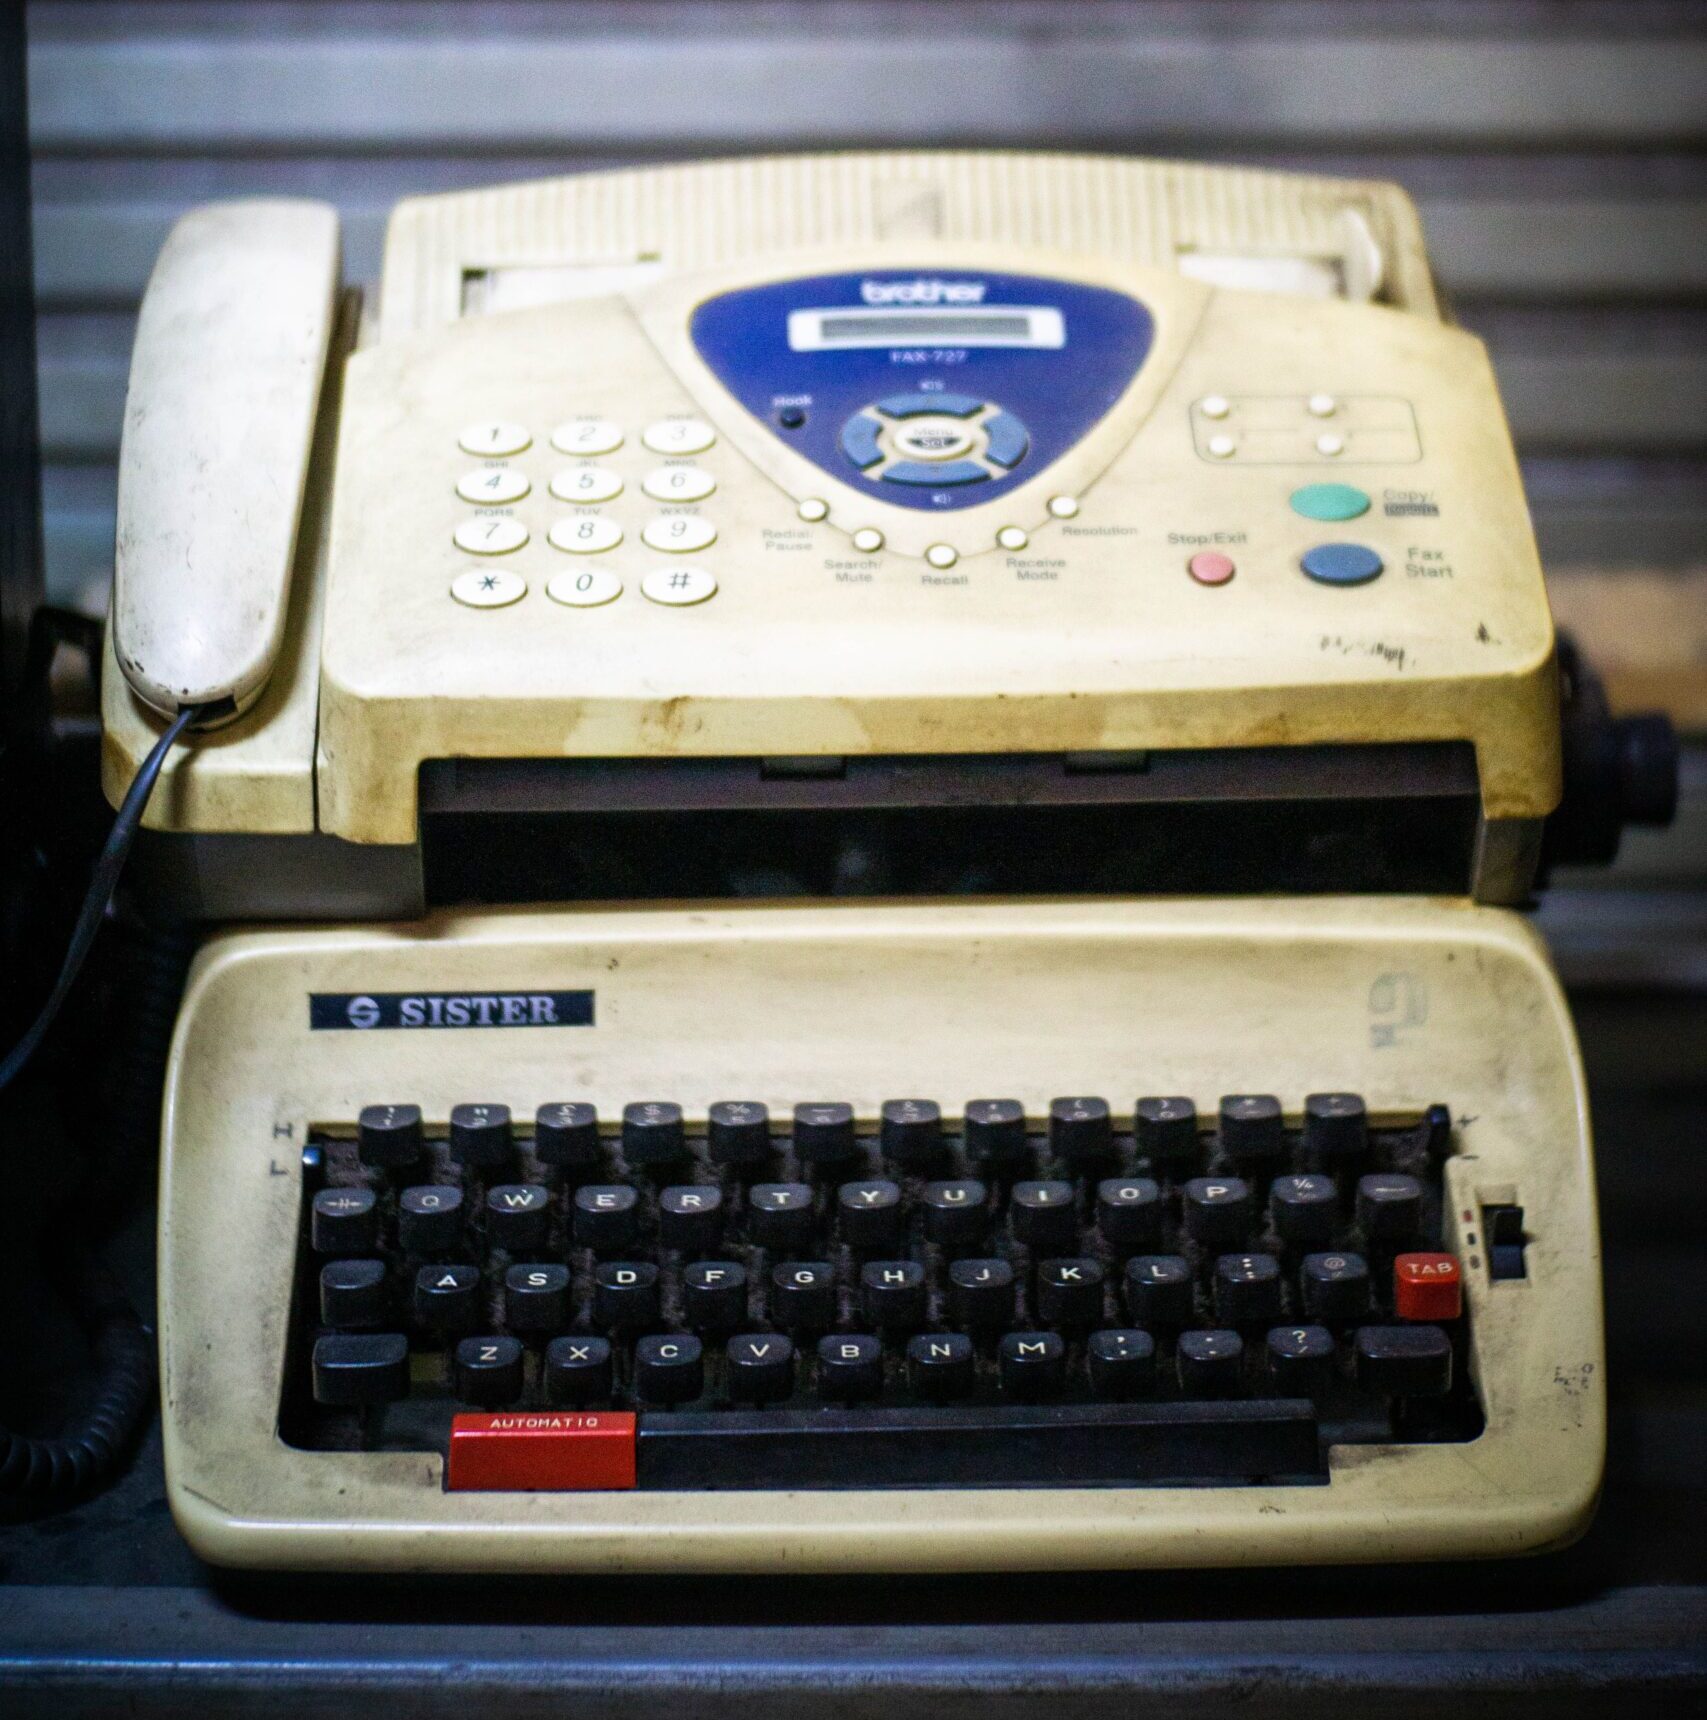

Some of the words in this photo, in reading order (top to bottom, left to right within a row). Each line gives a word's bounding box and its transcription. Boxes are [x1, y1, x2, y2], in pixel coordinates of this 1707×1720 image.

[862, 281, 985, 303] brother
[890, 350, 968, 363] FAX-727
[489, 427, 500, 442] 1
[578, 426, 596, 442] 2
[671, 425, 687, 441] 3
[485, 474, 502, 489] 4
[578, 473, 595, 489] 5
[671, 472, 686, 487] 6
[485, 522, 500, 540] 7
[577, 521, 595, 539] 8
[671, 520, 687, 537] 9
[1407, 547, 1444, 561] Fax
[1405, 563, 1455, 578] Start
[400, 995, 559, 1027] SISTER
[772, 1192, 791, 1205] T
[860, 1190, 880, 1203] Y
[944, 1189, 966, 1201] U
[1038, 1190, 1048, 1202] I
[1119, 1187, 1140, 1200] O
[1206, 1186, 1229, 1198] P
[421, 1195, 440, 1207] Q
[504, 1193, 534, 1207] W
[596, 1193, 616, 1207] E
[681, 1194, 702, 1207] R
[975, 1268, 990, 1281] J
[1060, 1267, 1082, 1280] K
[1151, 1265, 1168, 1277] L
[1407, 1262, 1453, 1275] TAB
[437, 1274, 458, 1287] A
[528, 1272, 548, 1286] S
[616, 1270, 637, 1284] D
[705, 1270, 725, 1283] F
[794, 1270, 815, 1284] G
[883, 1269, 905, 1283] H
[479, 1346, 498, 1361] Z
[569, 1346, 590, 1360] X
[660, 1345, 679, 1358] C
[749, 1344, 770, 1358] V
[840, 1345, 860, 1358] B
[930, 1343, 951, 1357] N
[1018, 1341, 1046, 1355] M
